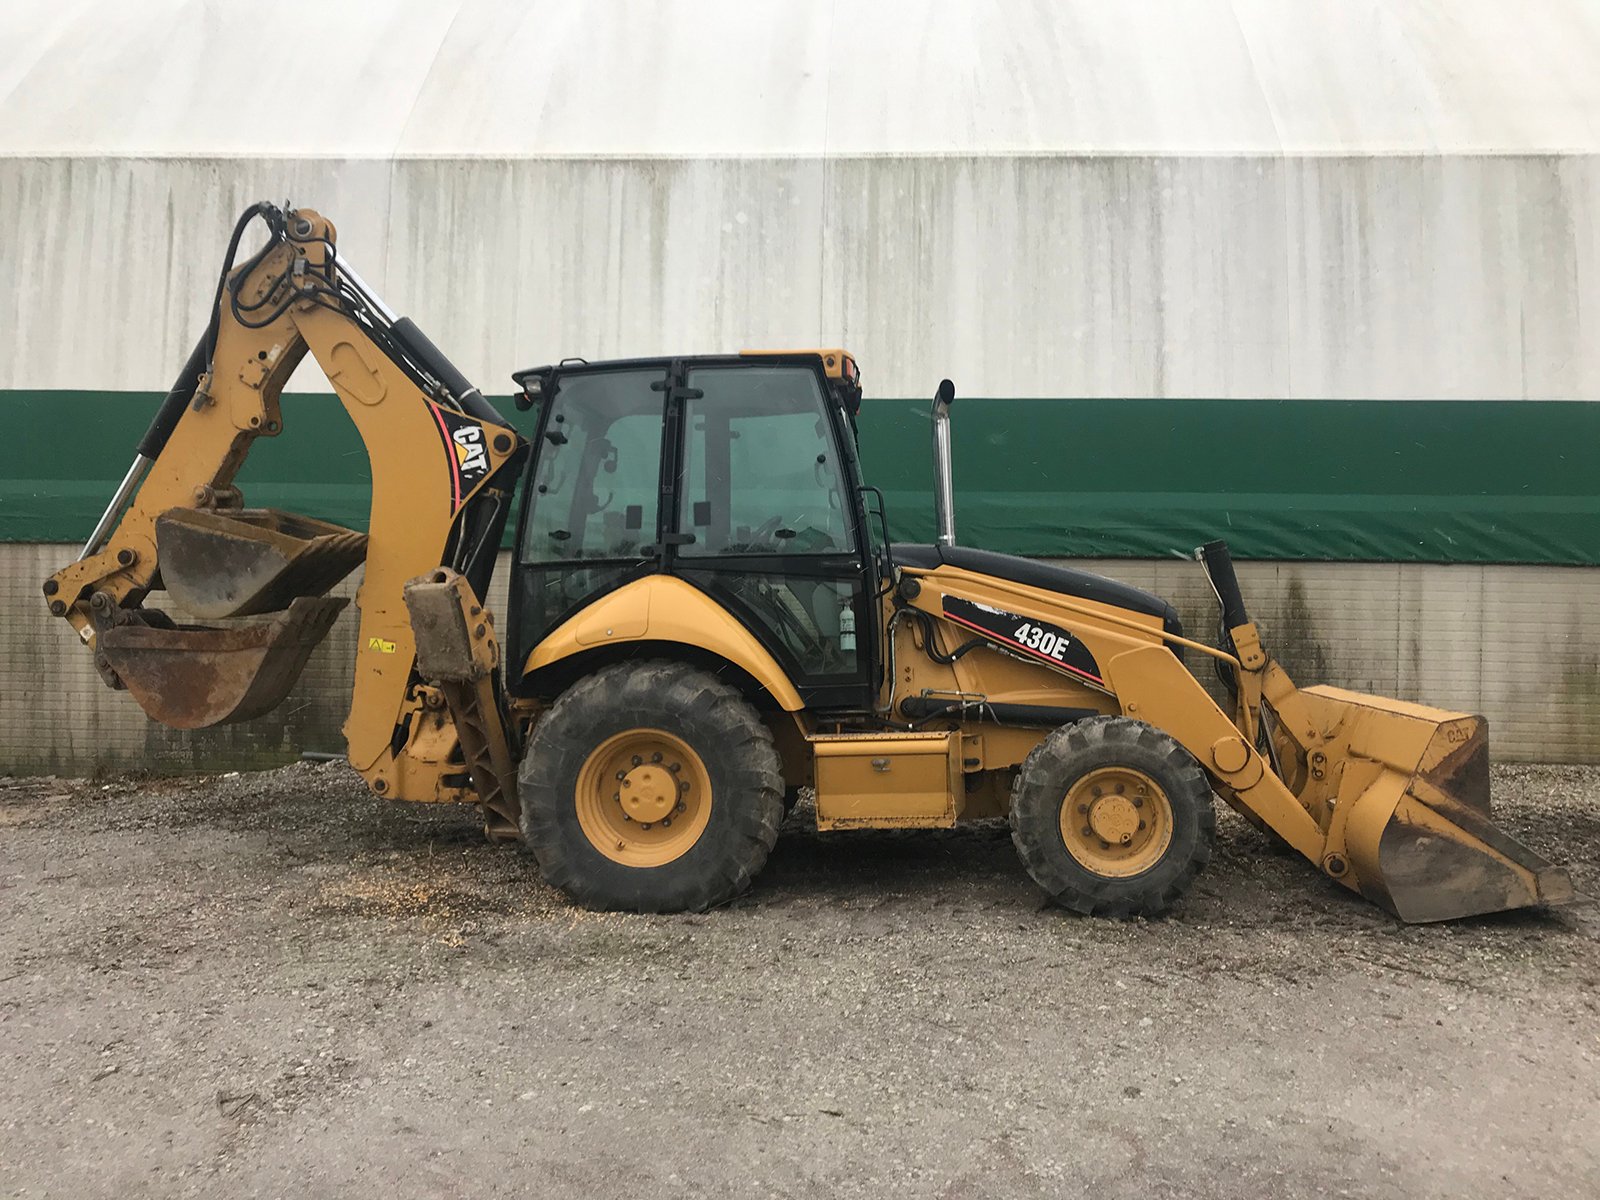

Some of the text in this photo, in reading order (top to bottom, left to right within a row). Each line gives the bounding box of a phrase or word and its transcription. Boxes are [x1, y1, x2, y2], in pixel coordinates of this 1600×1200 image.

[453, 426, 487, 471] CAT
[1014, 623, 1069, 660] 430E
[1447, 727, 1470, 743] CAT
